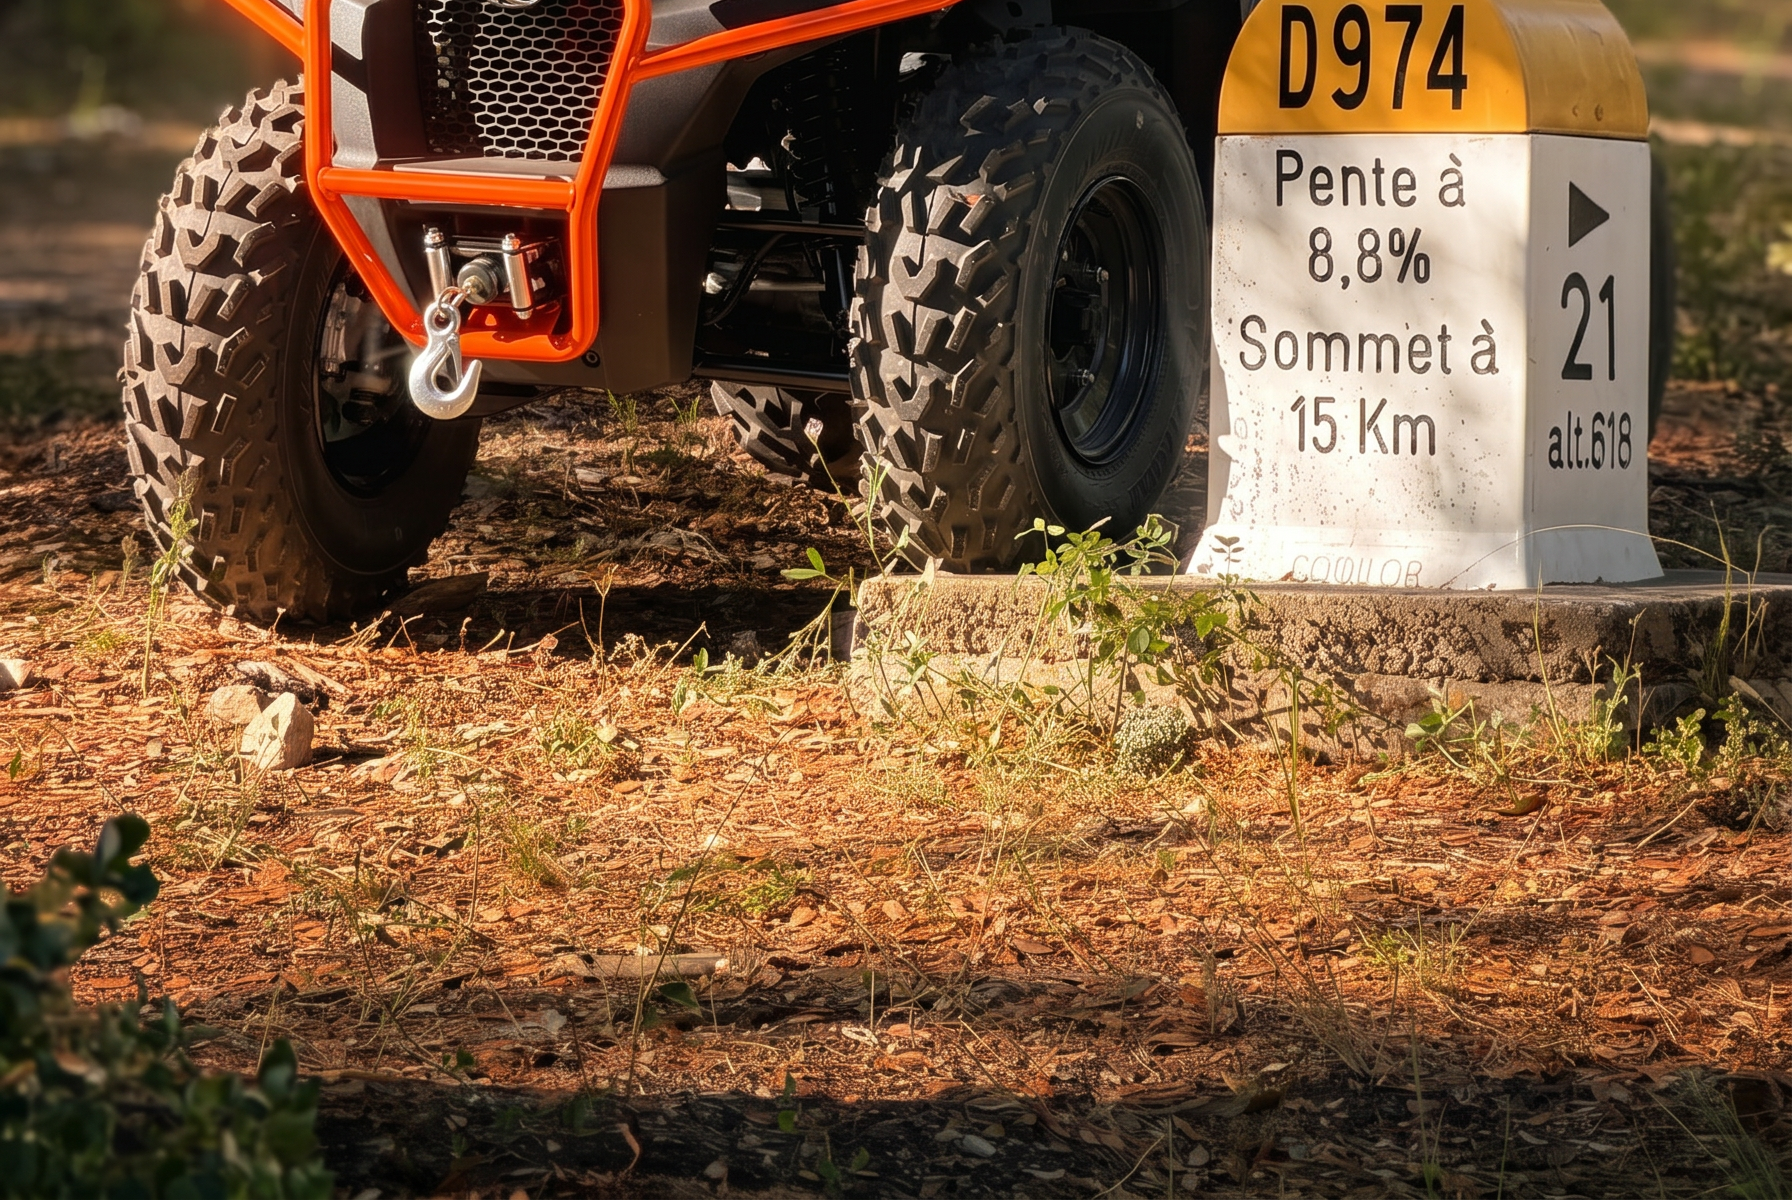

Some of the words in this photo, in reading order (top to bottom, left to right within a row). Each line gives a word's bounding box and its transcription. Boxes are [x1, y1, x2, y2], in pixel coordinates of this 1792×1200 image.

[1278, 3, 1468, 111] D974
[1275, 149, 1417, 208] Pente
[1438, 153, 1466, 208] à
[1308, 226, 1431, 290] 8,8%
[1239, 314, 1452, 375] Sommet
[1470, 318, 1499, 376] à
[1560, 271, 1616, 382] 21
[1290, 395, 1337, 454] 15
[1359, 397, 1436, 457] Km
[1547, 410, 1632, 471] alt.618
